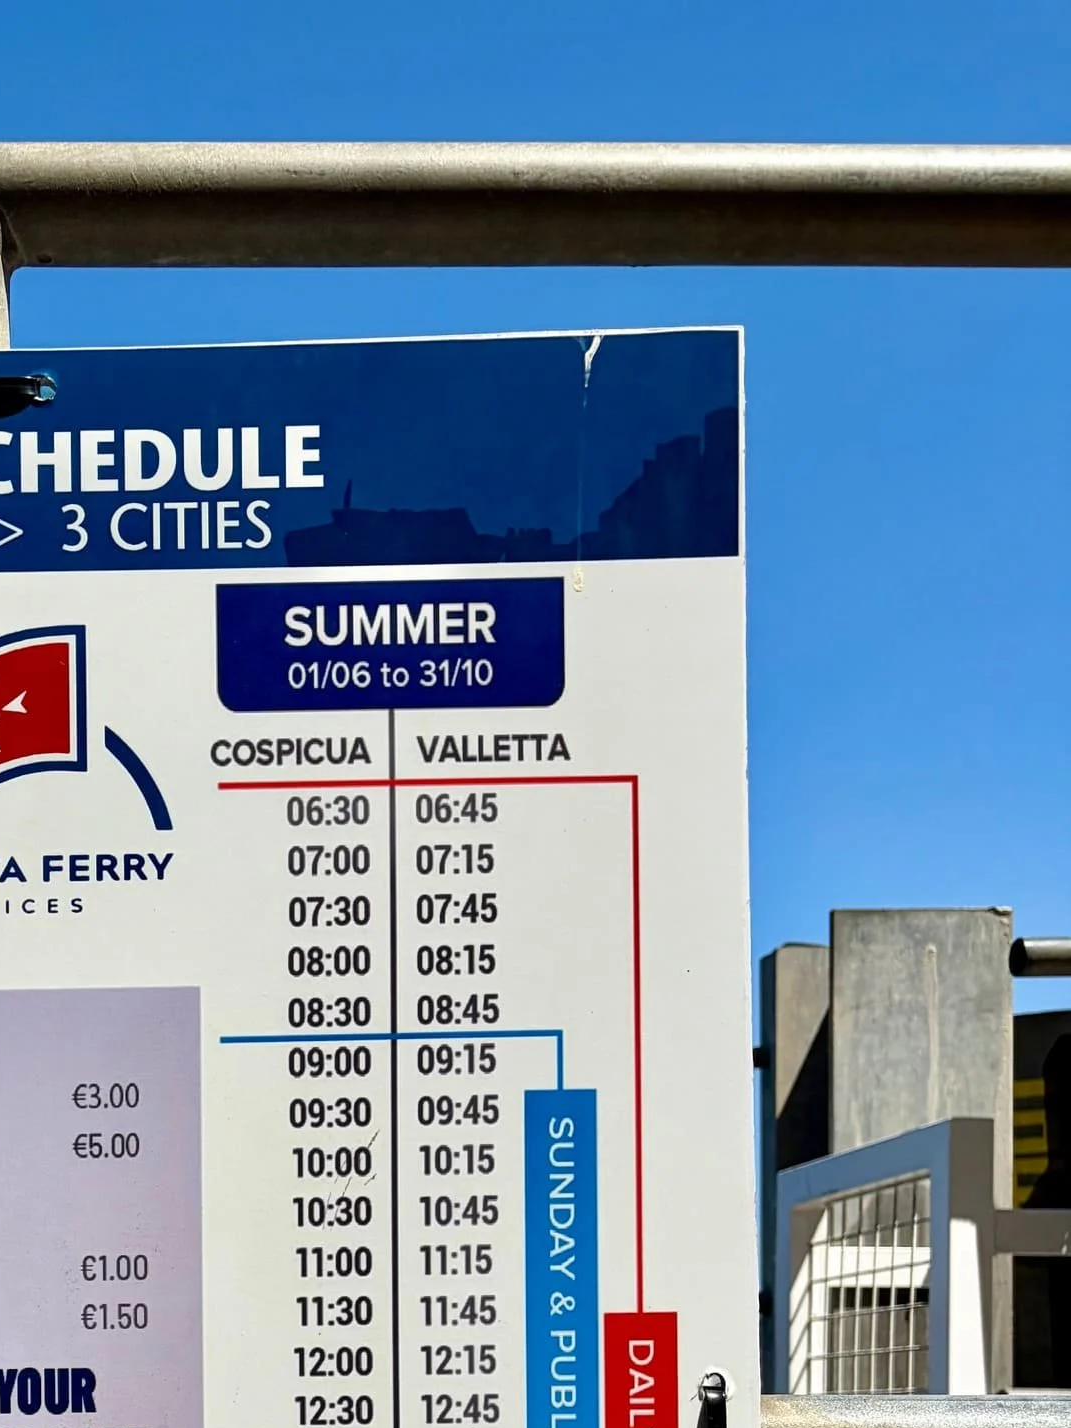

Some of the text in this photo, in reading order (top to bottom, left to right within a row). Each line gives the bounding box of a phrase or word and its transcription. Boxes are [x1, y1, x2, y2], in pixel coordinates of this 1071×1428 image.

[61, 503, 89, 552] 3
[110, 499, 272, 551] CITIES
[284, 602, 496, 647] SUMMER
[288, 657, 493, 689] 01/06 to 31/10
[210, 733, 571, 767] COSPICUA VALLETTA
[286, 792, 498, 827] 06:30 06:45
[42, 852, 174, 883] FERRY
[71, 1082, 140, 1109] €3.00
[72, 1132, 140, 1159] €5.00
[292, 1194, 499, 1227] 10:30 10:45
[548, 1117, 576, 1281] SUNDAY
[80, 1254, 148, 1282] €1.00
[80, 1302, 148, 1330] €1.50
[550, 1291, 576, 1316] &
